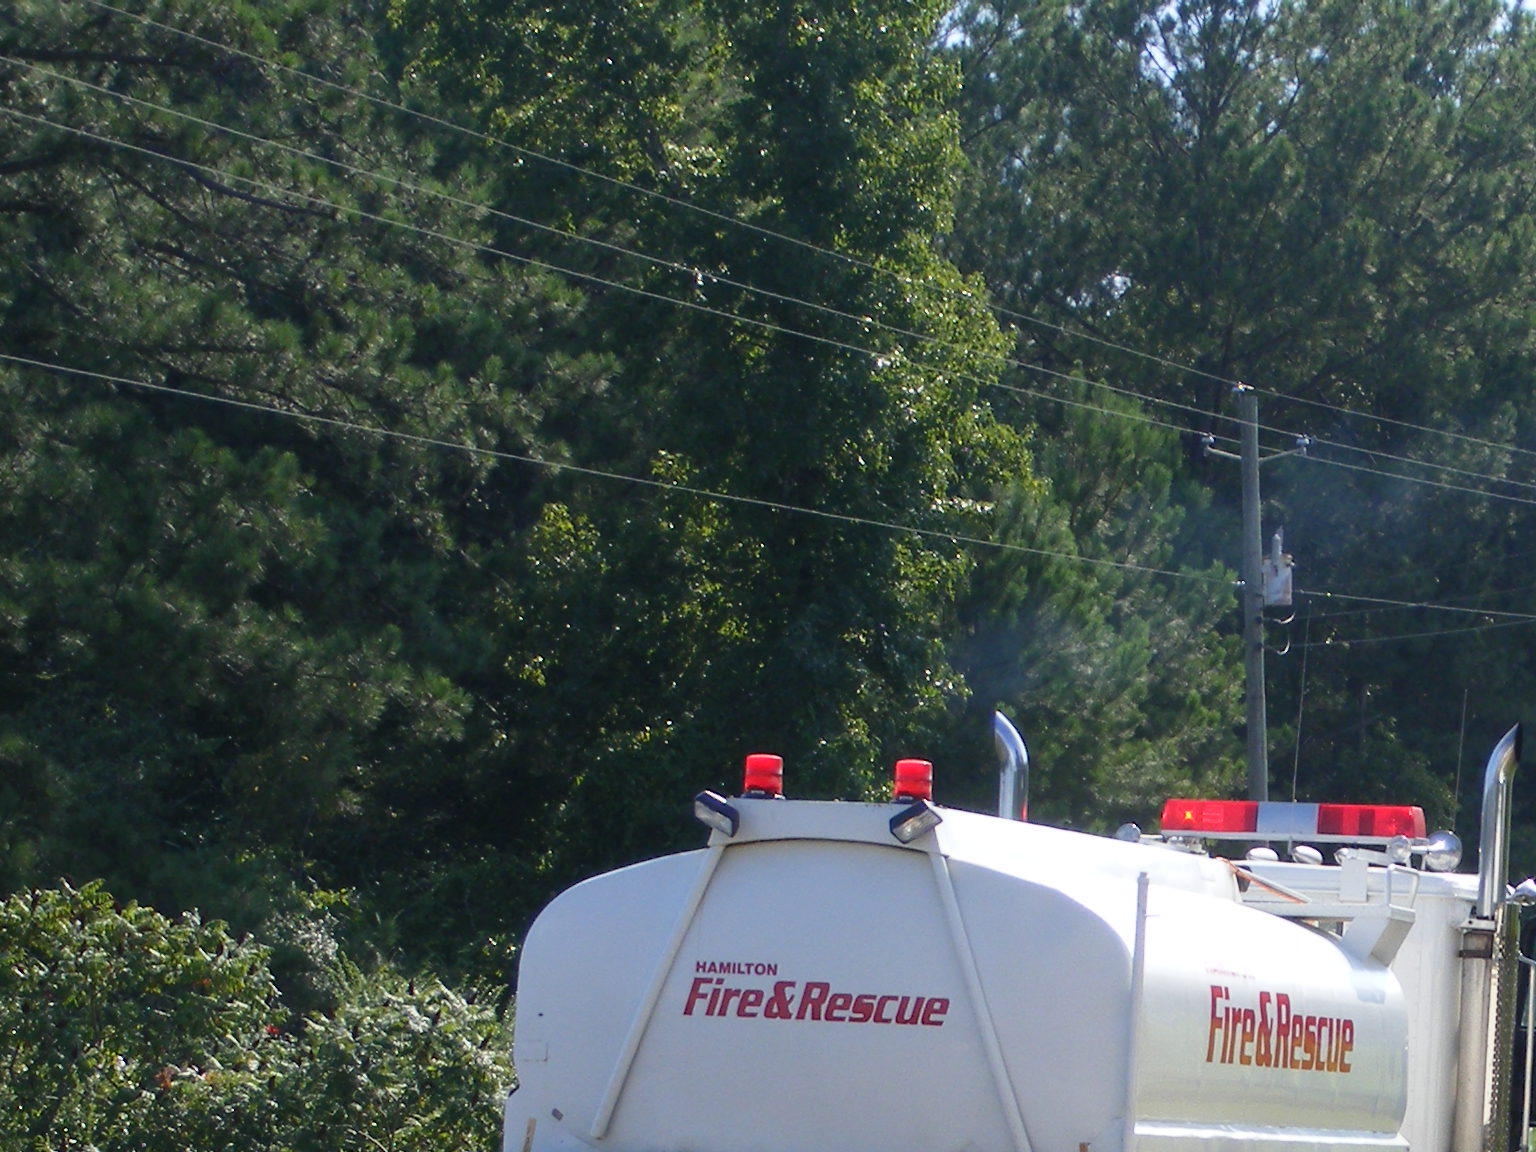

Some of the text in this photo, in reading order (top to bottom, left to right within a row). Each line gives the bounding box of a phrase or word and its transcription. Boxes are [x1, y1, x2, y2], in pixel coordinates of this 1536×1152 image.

[695, 961, 778, 976] HAMILTON
[683, 977, 950, 1026] Fire&Rescue
[1206, 985, 1354, 1073] Fire&Rescue
